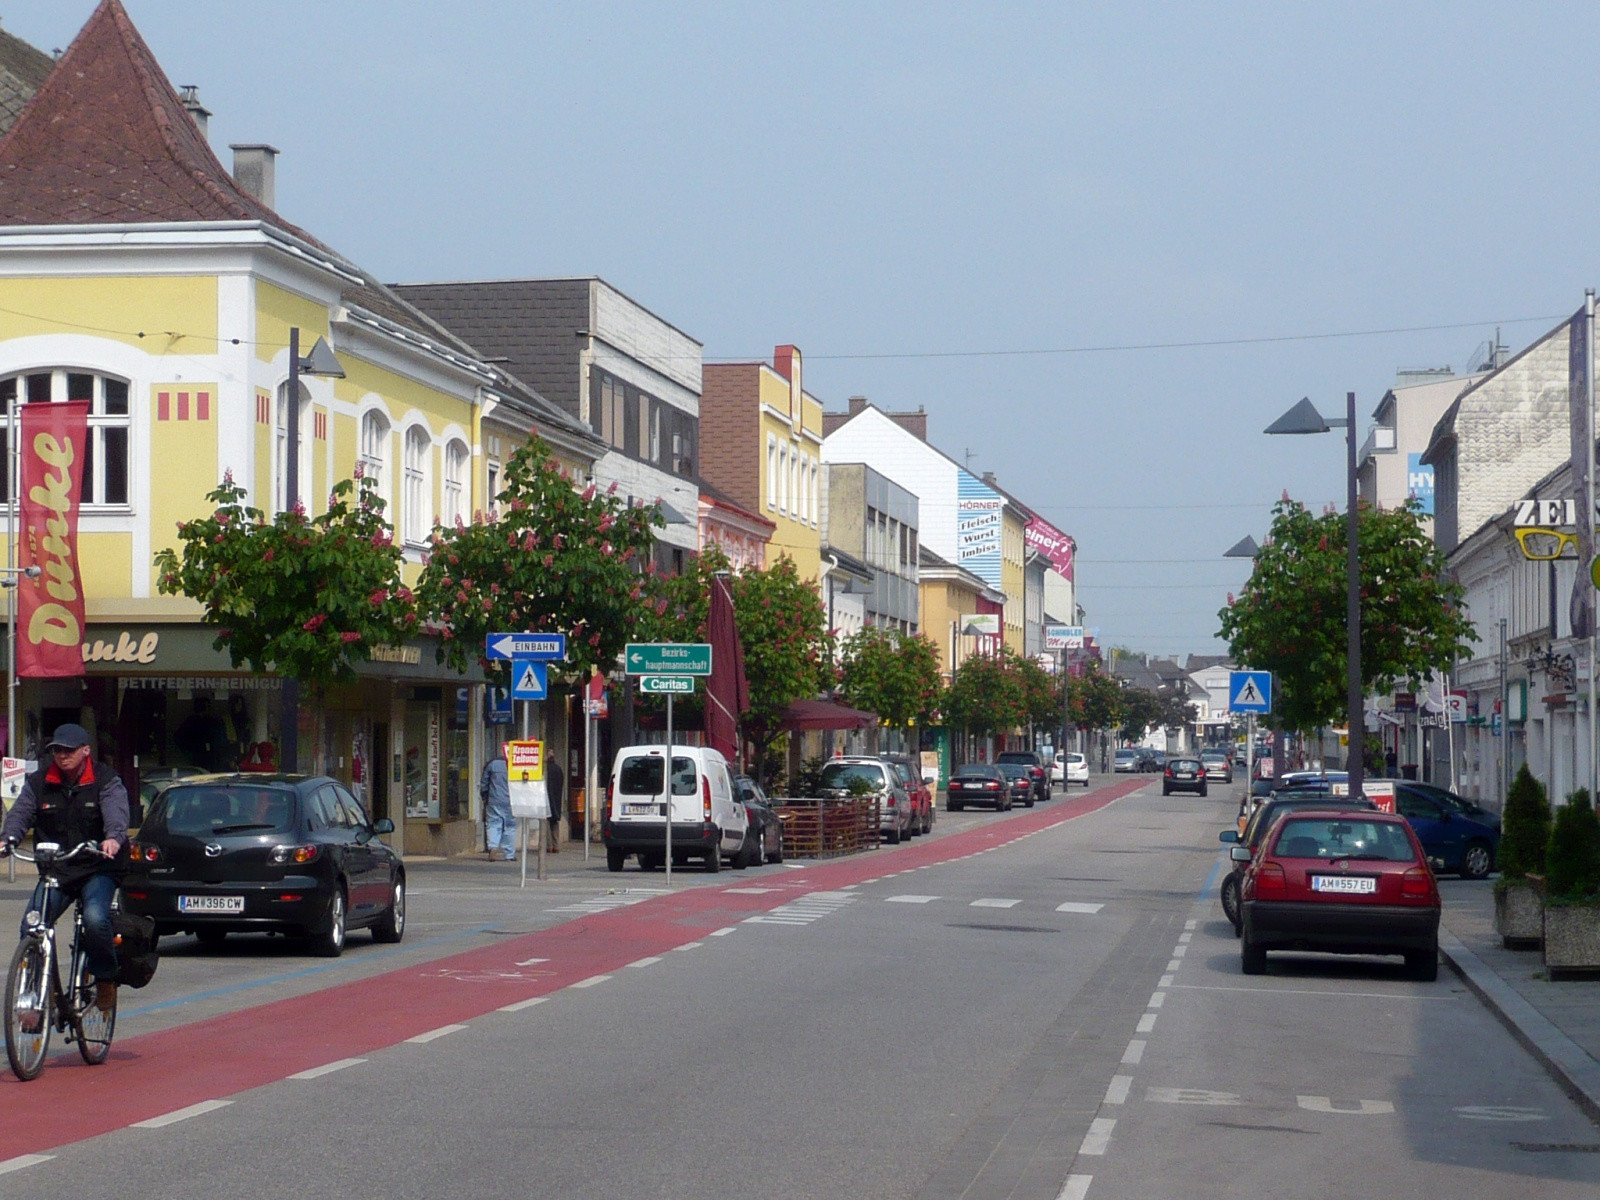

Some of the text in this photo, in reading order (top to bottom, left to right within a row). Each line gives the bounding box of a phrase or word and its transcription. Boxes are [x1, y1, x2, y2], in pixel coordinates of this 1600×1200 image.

[1409, 472, 1434, 488] HY
[959, 501, 999, 510] HÖRNER
[1514, 499, 1600, 526] ZEI
[961, 514, 997, 530] Fleisch
[963, 529, 994, 544] Wurst
[1025, 528, 1060, 550] einer
[962, 544, 996, 558] Imbiss
[82, 631, 159, 664] unkl
[515, 642, 555, 651] EINBAHN
[662, 647, 691, 658] Bezirks-
[645, 660, 707, 671] hauptmannschaft
[118, 677, 283, 690] BETTFEDERN-REINIGU
[651, 679, 688, 690] Caritas
[513, 745, 539, 754] Kronen
[3, 759, 18, 769] NEU
[512, 754, 539, 764] Zeitung
[1321, 879, 1373, 890] AM 557 EU
[186, 898, 242, 908] AM 396 CW
